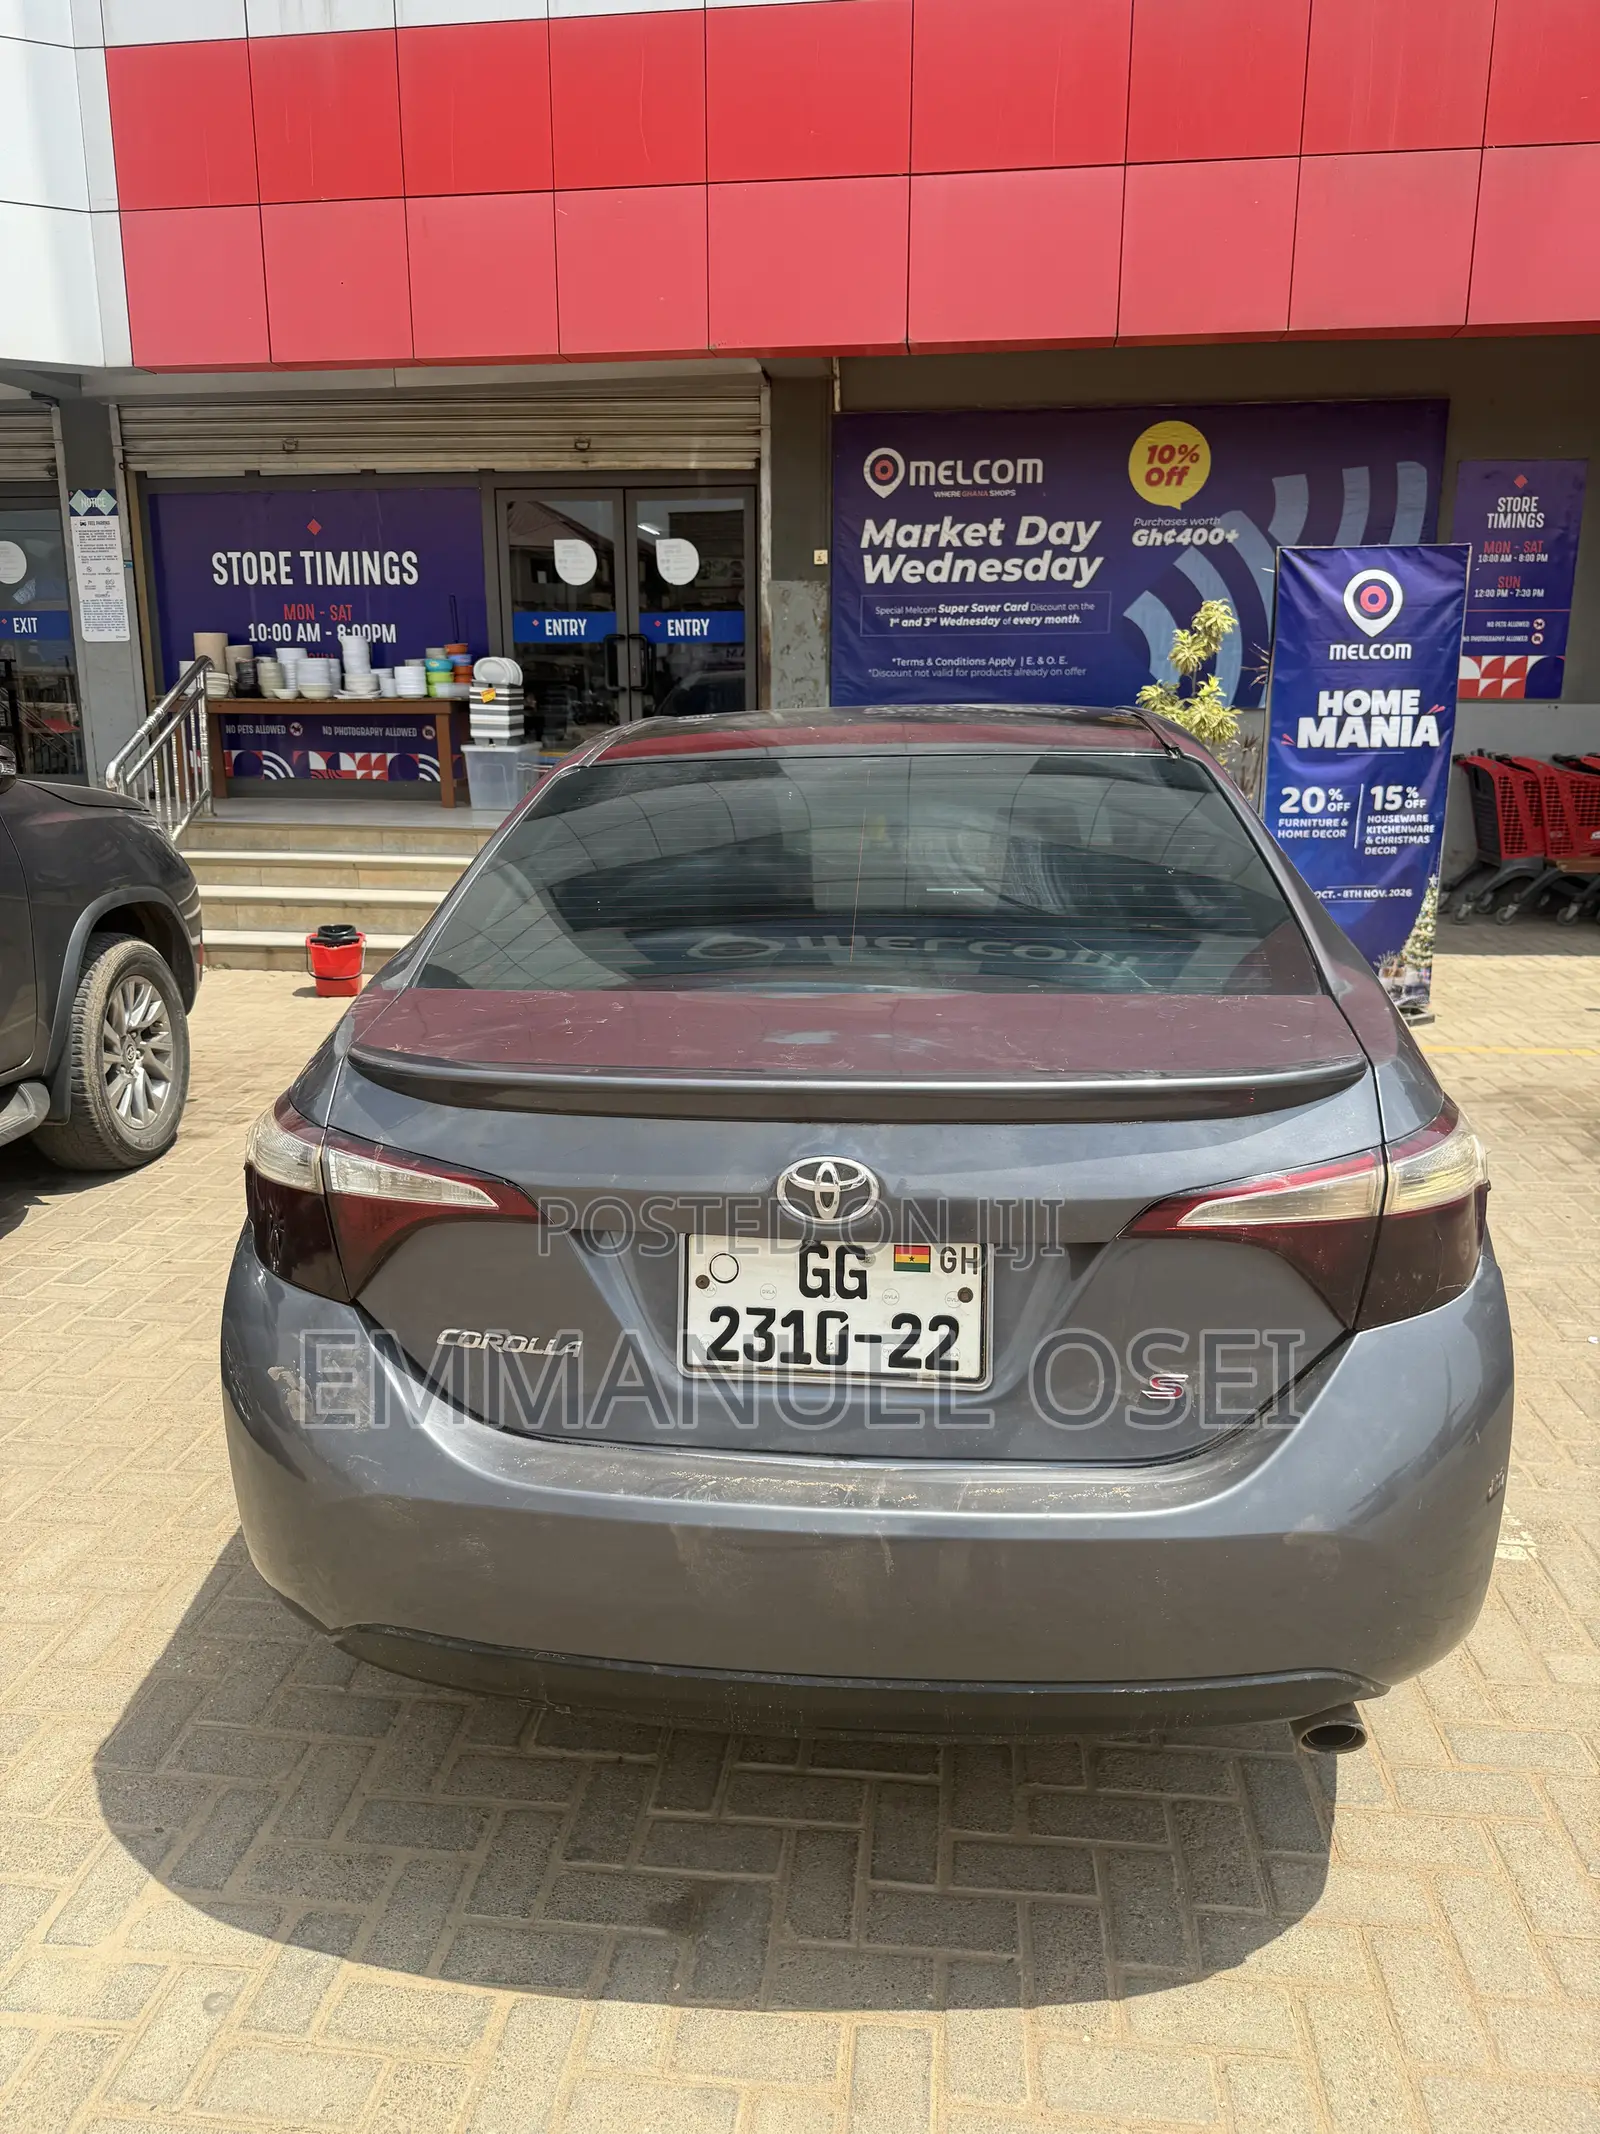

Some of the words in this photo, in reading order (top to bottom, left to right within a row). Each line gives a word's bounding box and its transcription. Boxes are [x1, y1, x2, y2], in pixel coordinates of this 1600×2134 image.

[1147, 444, 1200, 465] 10%
[909, 458, 1044, 486] MELCOM
[1144, 466, 1190, 487] Off
[962, 490, 988, 498] GHANA
[989, 489, 1016, 497] SHOPS
[81, 497, 107, 508] NOTICE
[1497, 497, 1539, 513] STORE
[1134, 517, 1187, 527] Purchases
[1189, 516, 1221, 526] worth
[1487, 513, 1545, 529] TIMINGS
[860, 516, 1005, 549] Market
[1015, 516, 1102, 552] Day
[1484, 541, 1511, 554] MON
[1523, 541, 1544, 553] SAT
[1478, 554, 1499, 563] 10:00
[1500, 554, 1512, 562] AM
[1536, 553, 1548, 562] PM
[212, 551, 294, 586] STORE
[300, 551, 419, 586] TIMINGS
[863, 550, 1104, 588] Wednesday
[1497, 576, 1521, 588] SUN
[1474, 589, 1495, 598] 12:00
[1496, 589, 1508, 597] PM
[1532, 589, 1544, 597] PM
[284, 603, 315, 621] MON
[330, 604, 352, 621] SAT
[875, 606, 904, 616] Special
[905, 606, 936, 614] Melcom
[938, 604, 969, 614] Super
[970, 603, 1001, 613] Saver
[1003, 602, 1029, 612] Card
[1030, 603, 1067, 611] Discount
[1080, 602, 1095, 610] the
[13, 617, 38, 633] EXIT
[901, 617, 922, 627] and
[924, 617, 937, 627] 3rd
[939, 616, 1001, 627] Wednesday
[1002, 616, 1012, 625] of
[1013, 617, 1042, 626] every
[1044, 614, 1082, 624] month.
[248, 623, 292, 642] 10:00
[296, 623, 321, 642] AM
[544, 619, 587, 636] ENTRY
[667, 619, 710, 637] ENTRY
[1329, 643, 1412, 661] MELCOM
[926, 658, 933, 666] &
[935, 657, 986, 666] Conditions
[988, 657, 1016, 667] Apply
[1037, 656, 1044, 665] &
[914, 669, 930, 677] not
[931, 669, 954, 677] valid
[955, 668, 968, 676] for
[970, 668, 1012, 678] products
[1014, 668, 1049, 678] already
[1064, 667, 1087, 676] offer
[1317, 688, 1421, 718] HOME
[226, 725, 235, 734] NO
[238, 725, 253, 734] PETS
[255, 725, 286, 734] ALLOWED
[322, 726, 332, 736] NO
[334, 726, 383, 737] PHOTOGRAPHY
[385, 727, 417, 737] ALLOWED
[1297, 716, 1441, 748] MANIA
[1327, 802, 1351, 812] OFF
[1404, 799, 1427, 809] OFF
[1278, 818, 1340, 827] FURNITURE
[1341, 818, 1349, 827] &
[1367, 814, 1429, 823] HOUSEWARE
[1277, 830, 1310, 838] HOME
[1312, 829, 1347, 838] DECOR
[1366, 825, 1435, 834] KITCHENWARE
[1365, 836, 1373, 844] &
[1375, 836, 1430, 845] CHRISTMAS
[1364, 847, 1397, 855] DECOR
[1343, 890, 1362, 898] 8TH
[1364, 889, 1387, 898] NOV.
[1389, 889, 1412, 897] 2026
[799, 1244, 868, 1299] GG
[939, 1246, 978, 1275] GH
[436, 1327, 583, 1358] COROLLA
[706, 1305, 960, 1371] 2310-22
